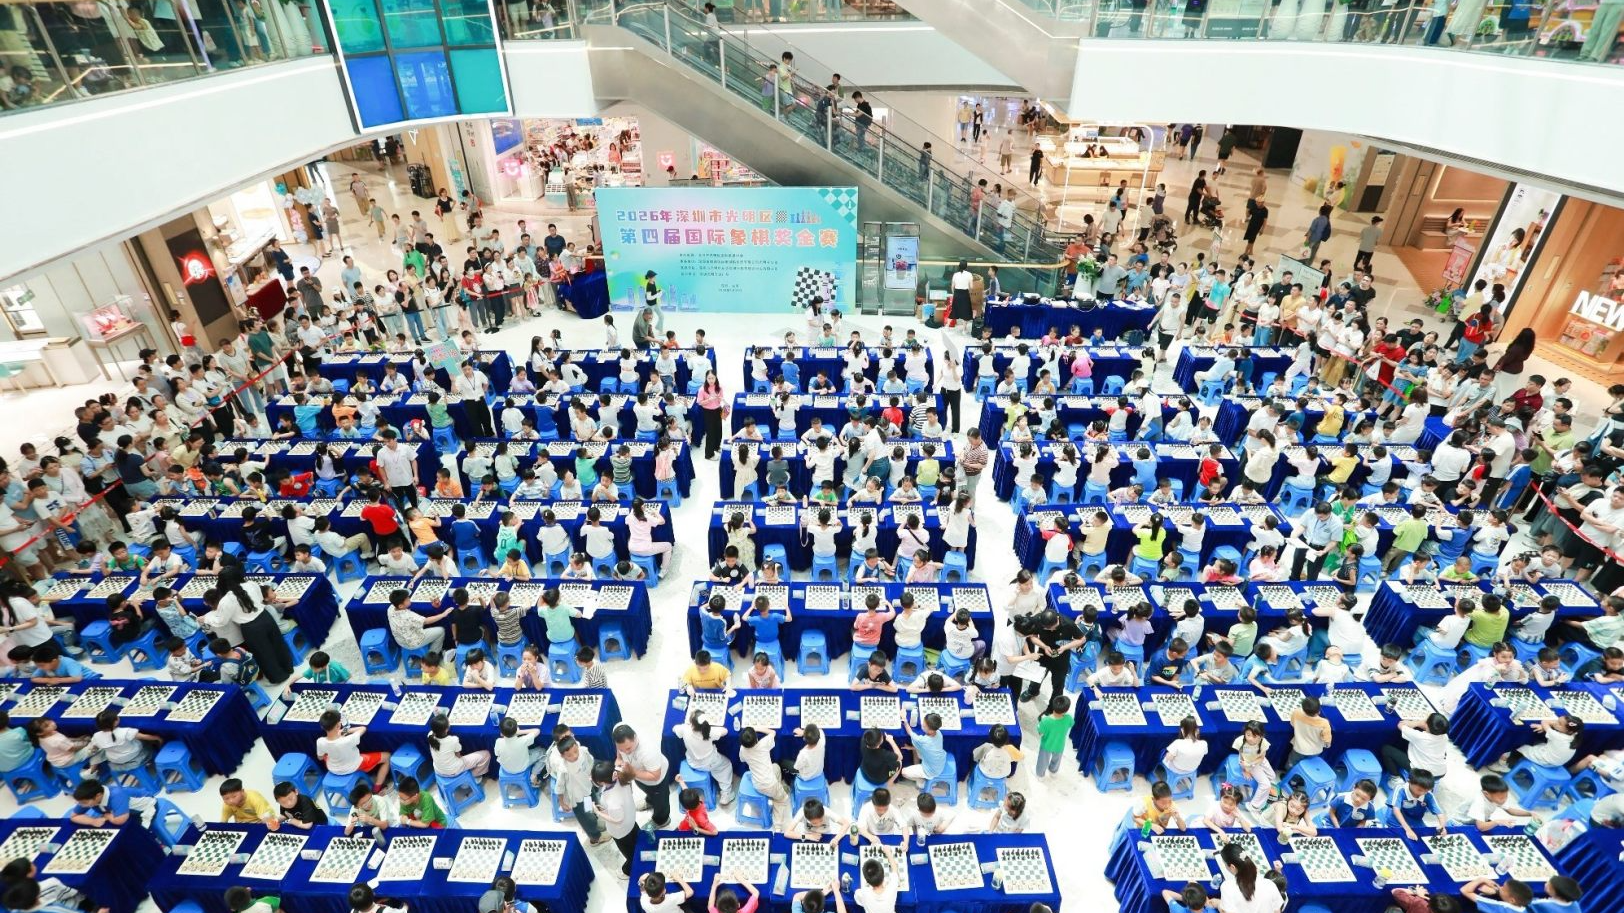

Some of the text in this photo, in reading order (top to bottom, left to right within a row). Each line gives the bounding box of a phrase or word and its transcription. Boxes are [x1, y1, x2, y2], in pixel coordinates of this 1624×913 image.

[616, 209, 772, 223] 2026年深圳市光明区
[619, 228, 838, 247] 第四届国际象棋奖金赛
